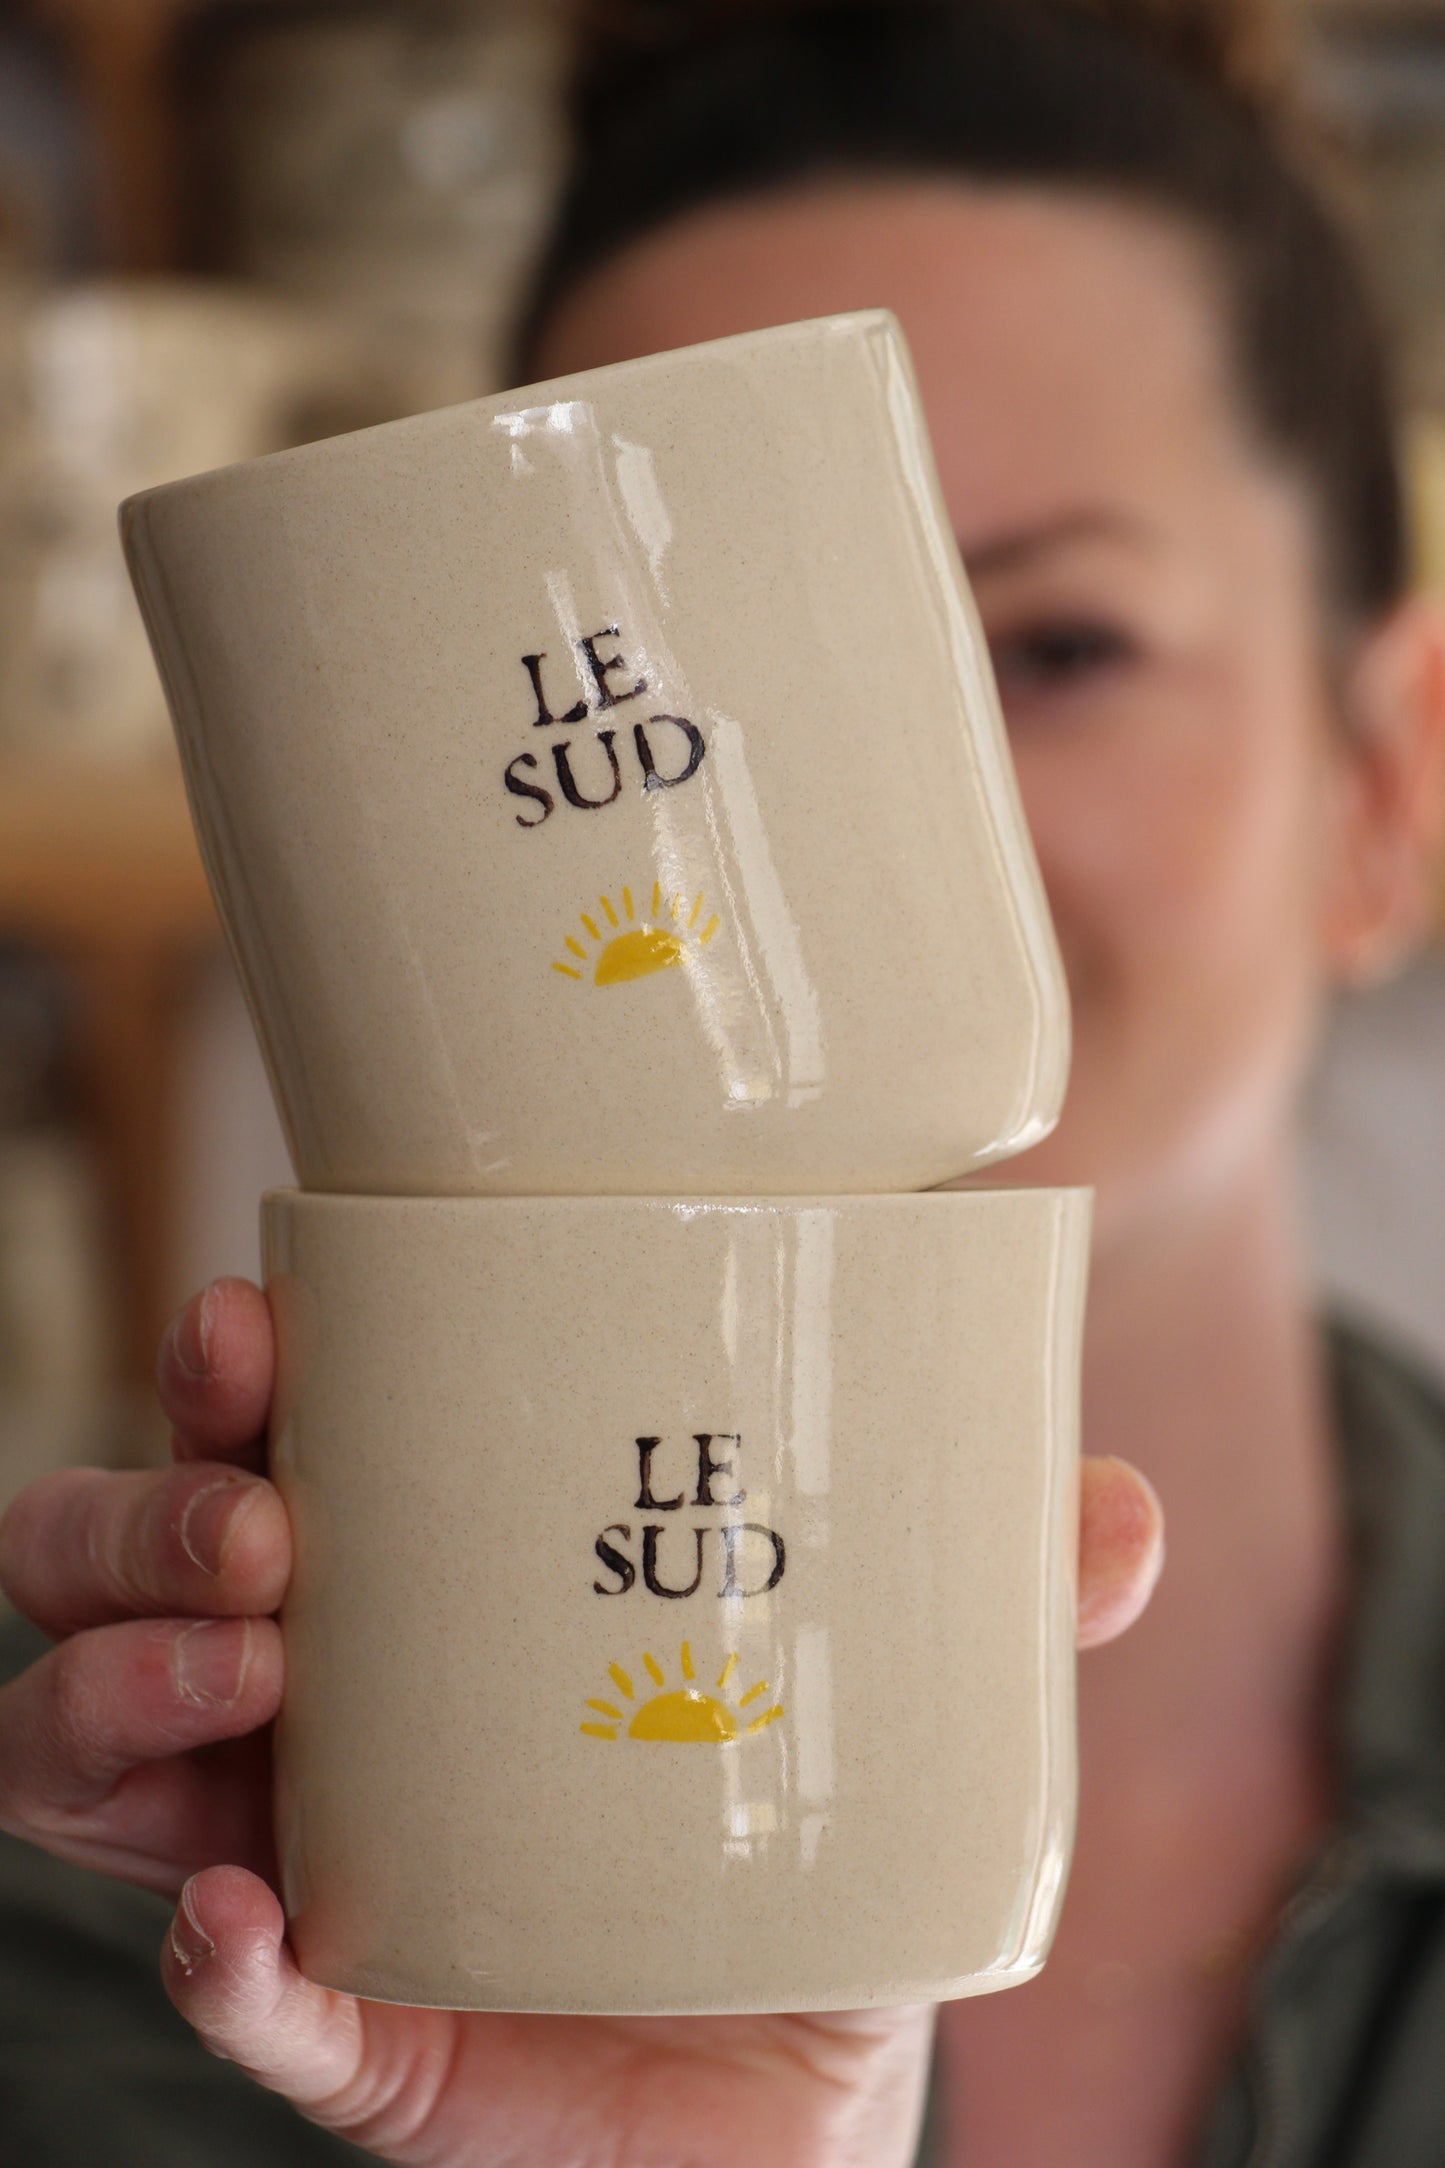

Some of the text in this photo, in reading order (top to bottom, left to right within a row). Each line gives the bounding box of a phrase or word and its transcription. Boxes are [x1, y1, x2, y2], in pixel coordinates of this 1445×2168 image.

[521, 627, 648, 727] LE
[503, 714, 706, 828] SUD
[633, 1433, 745, 1511] LE
[594, 1524, 786, 1599] SUD
